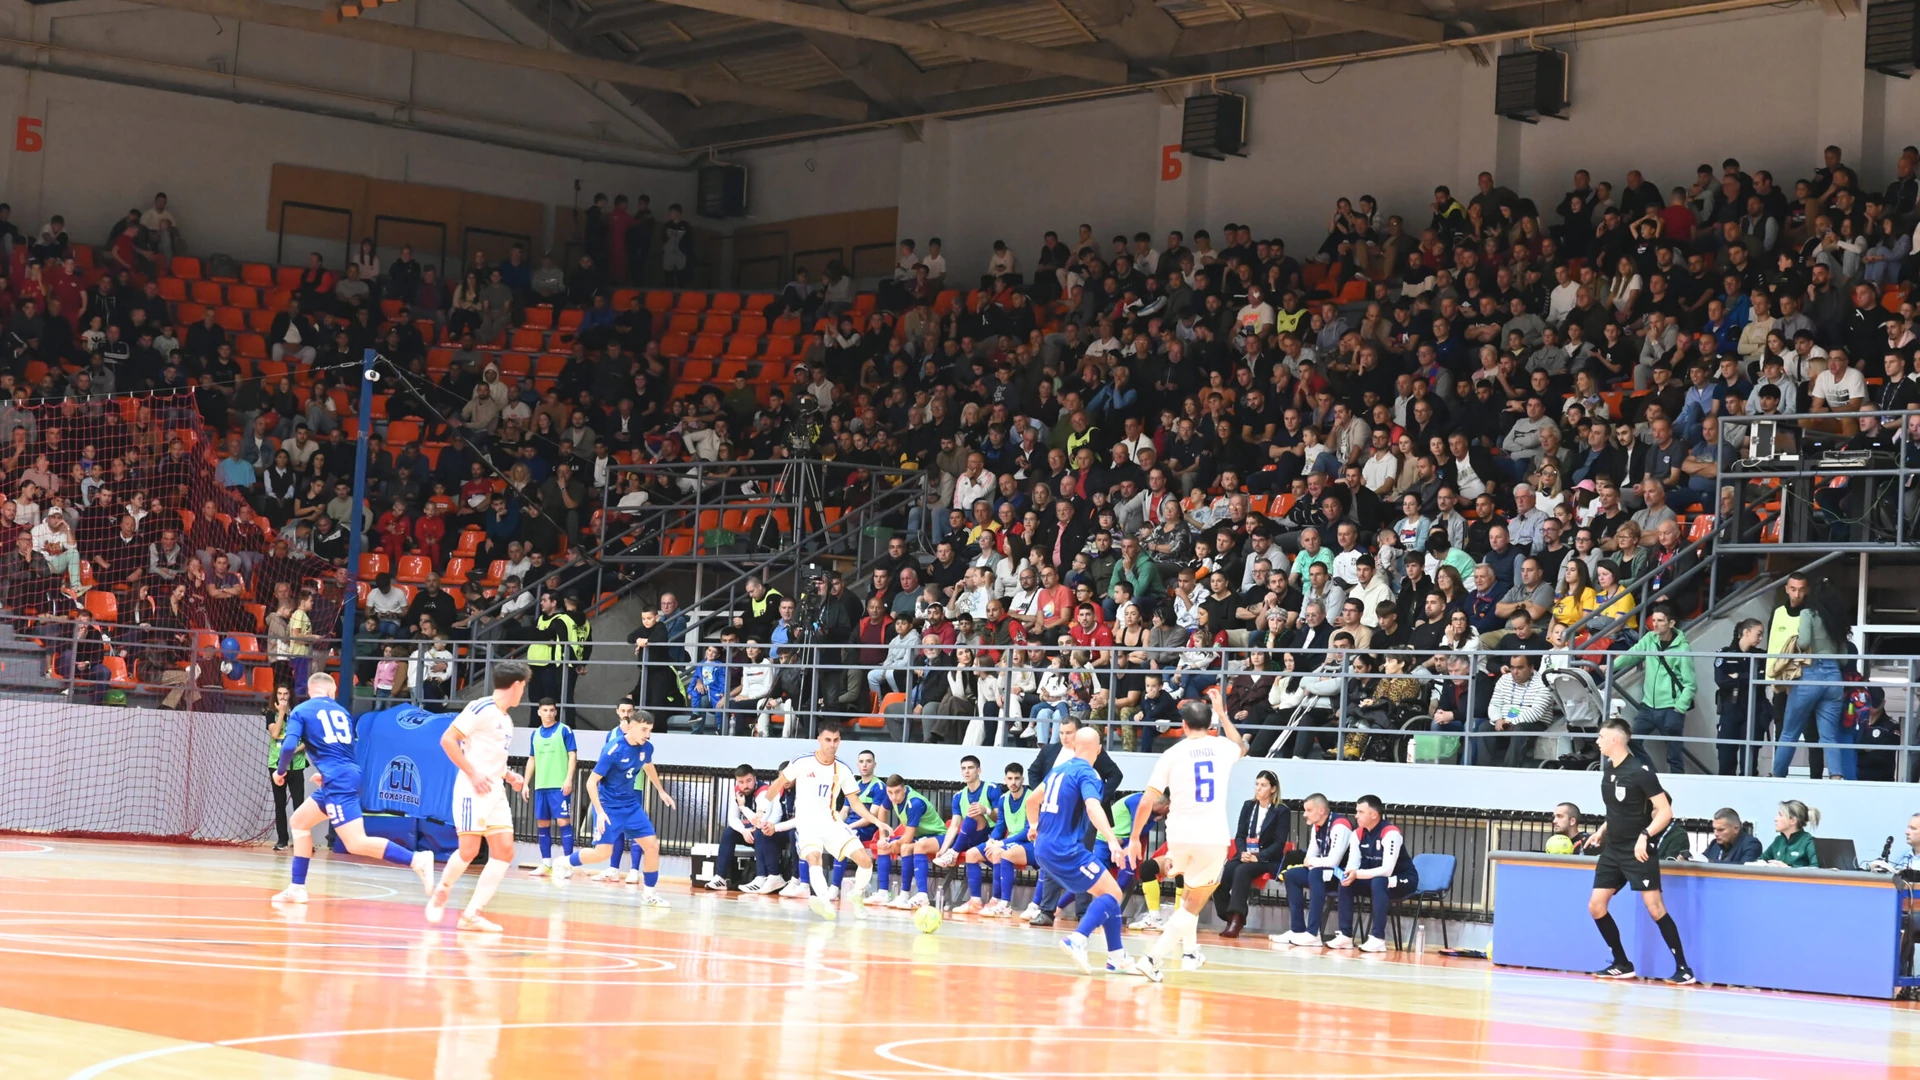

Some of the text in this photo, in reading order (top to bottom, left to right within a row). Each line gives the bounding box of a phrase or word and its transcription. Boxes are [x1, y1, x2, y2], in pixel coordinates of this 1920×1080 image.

[16, 116, 43, 152] Б
[1161, 144, 1183, 181] Б
[316, 709, 352, 744] 19
[818, 784, 829, 797] 17
[1041, 772, 1065, 814] 11
[1194, 761, 1214, 802] 6
[560, 800, 567, 811] 4
